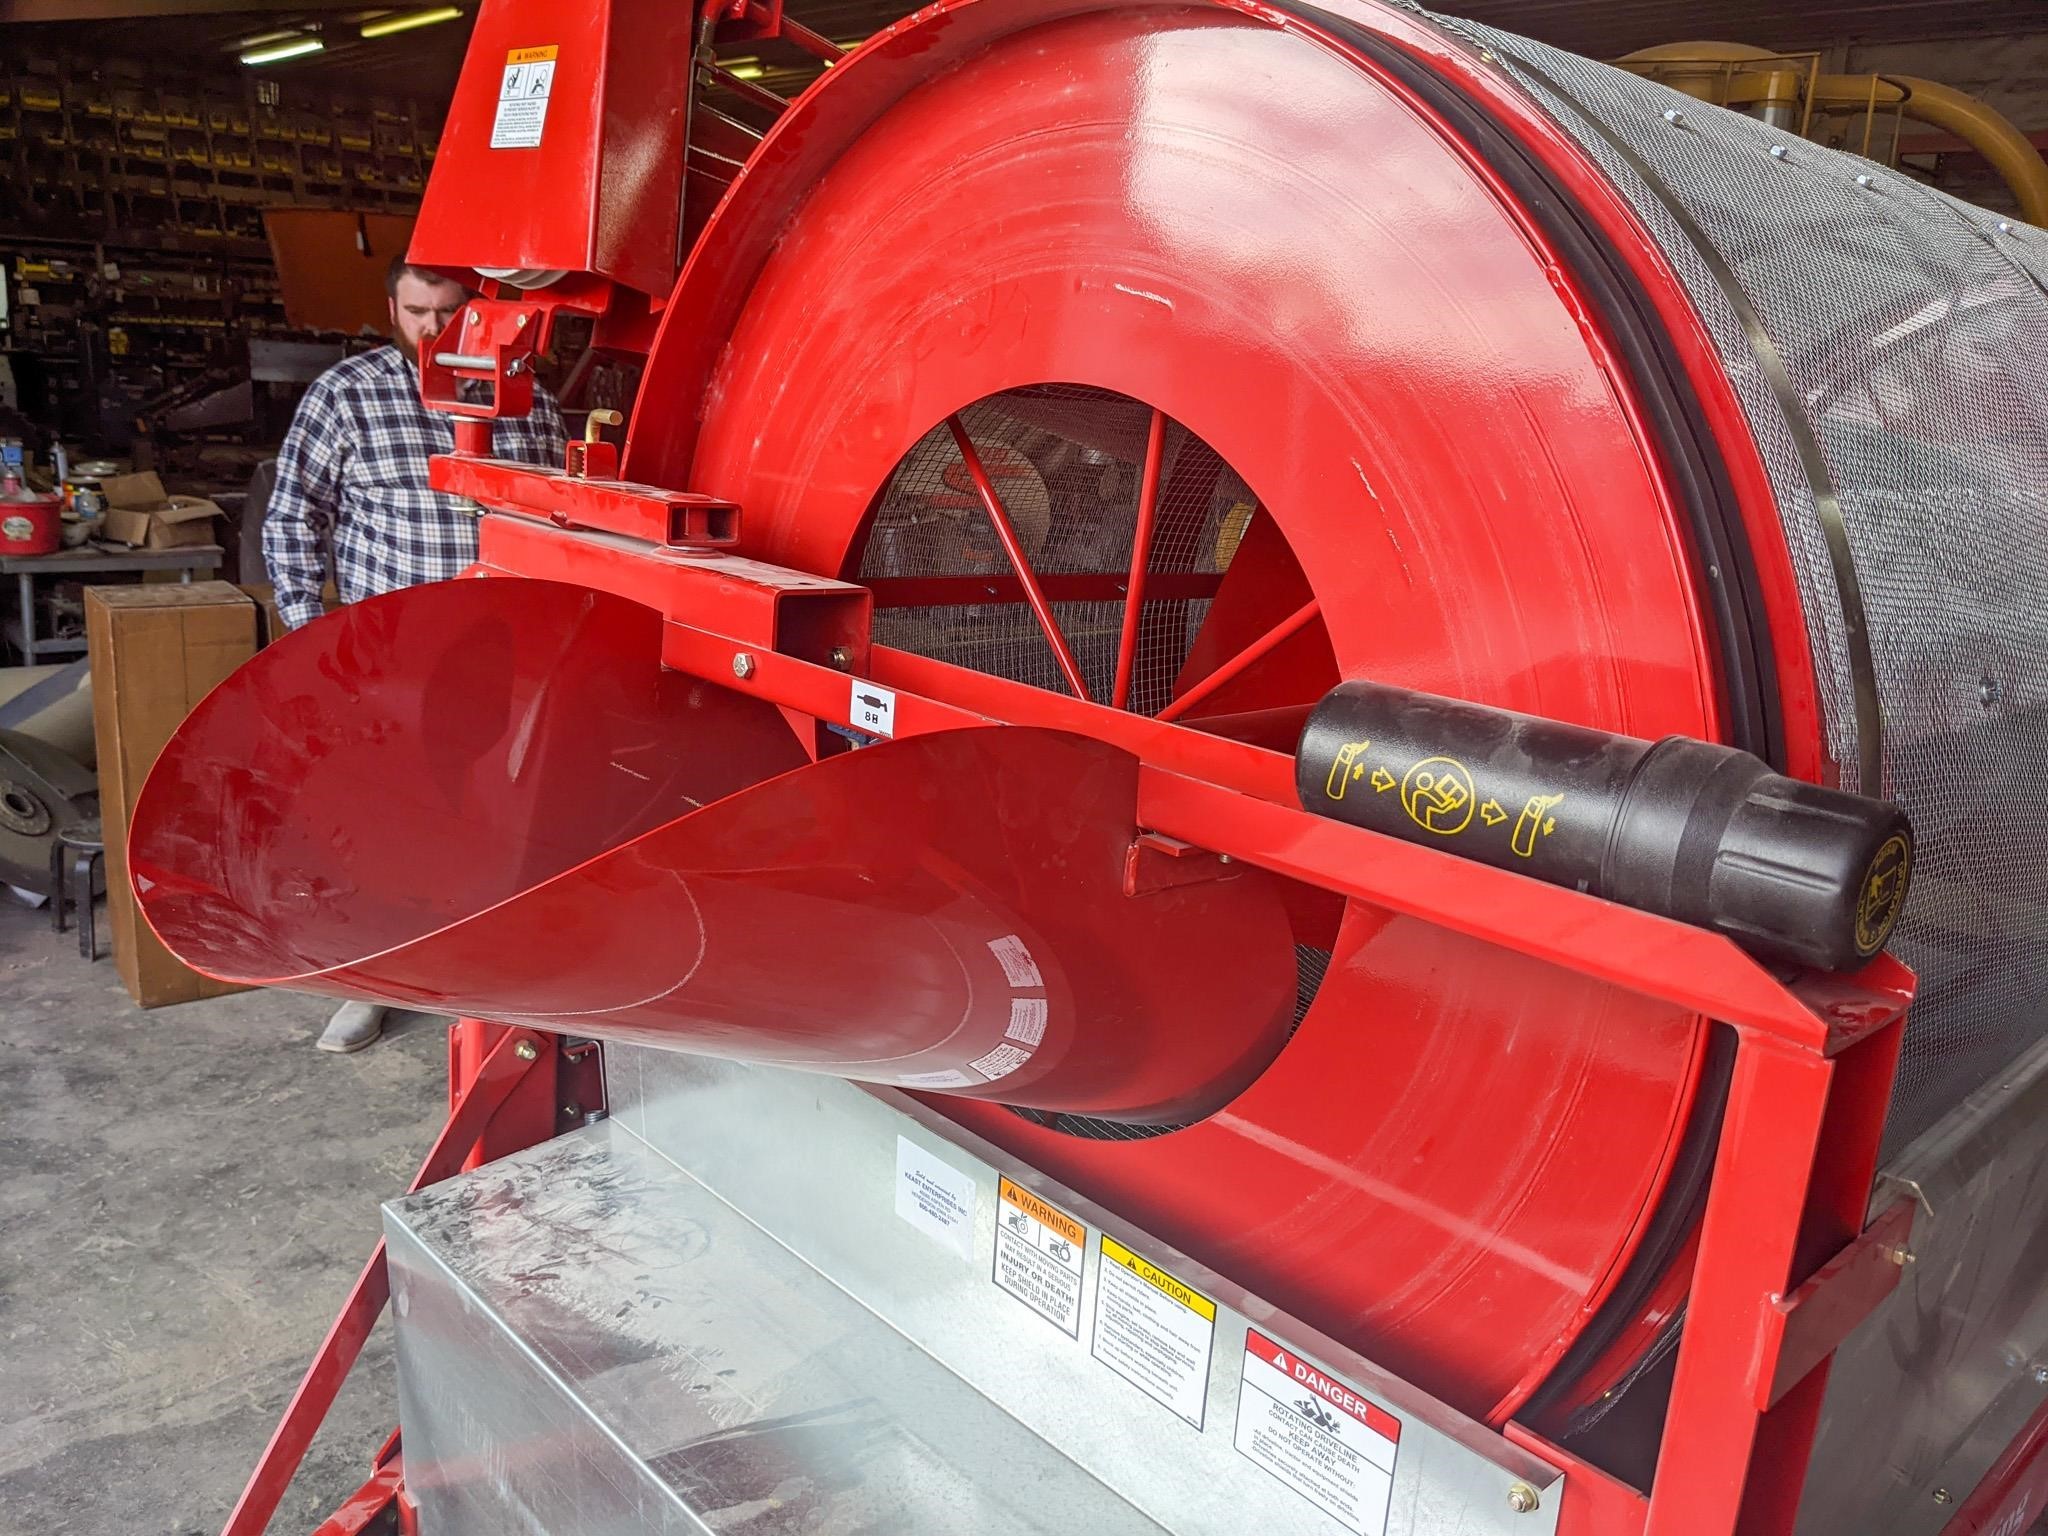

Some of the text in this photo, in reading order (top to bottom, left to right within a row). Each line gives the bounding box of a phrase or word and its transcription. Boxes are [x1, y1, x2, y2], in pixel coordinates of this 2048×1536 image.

[904, 1171, 921, 1186] KEAST
[921, 1182, 957, 1209] ENTERPRISES
[1020, 1192, 1076, 1240] WARNING
[1000, 1228, 1077, 1286] CONTACT WITH MOVING PARTS
[1000, 1249, 1074, 1306] INJURY OR DEATH!
[1004, 1241, 1070, 1292] MAY RESULT IN A SERIOUS
[1001, 1261, 1070, 1316] KEEP SHIELD IN PLACE
[1004, 1274, 1065, 1323] DURING OPERATION
[1142, 1265, 1191, 1305] CAUTION
[1294, 1362, 1367, 1420] DANGER
[1268, 1408, 1359, 1474] CONTACT CAN CAUSE DEATH
[1268, 1425, 1277, 1437] DO
[1278, 1432, 1291, 1446] NOT
[1292, 1441, 1322, 1466] OPERATE
[1272, 1401, 1357, 1463] ROTATING DRIVELINE
[1288, 1429, 1336, 1467] KEEP AWAY
